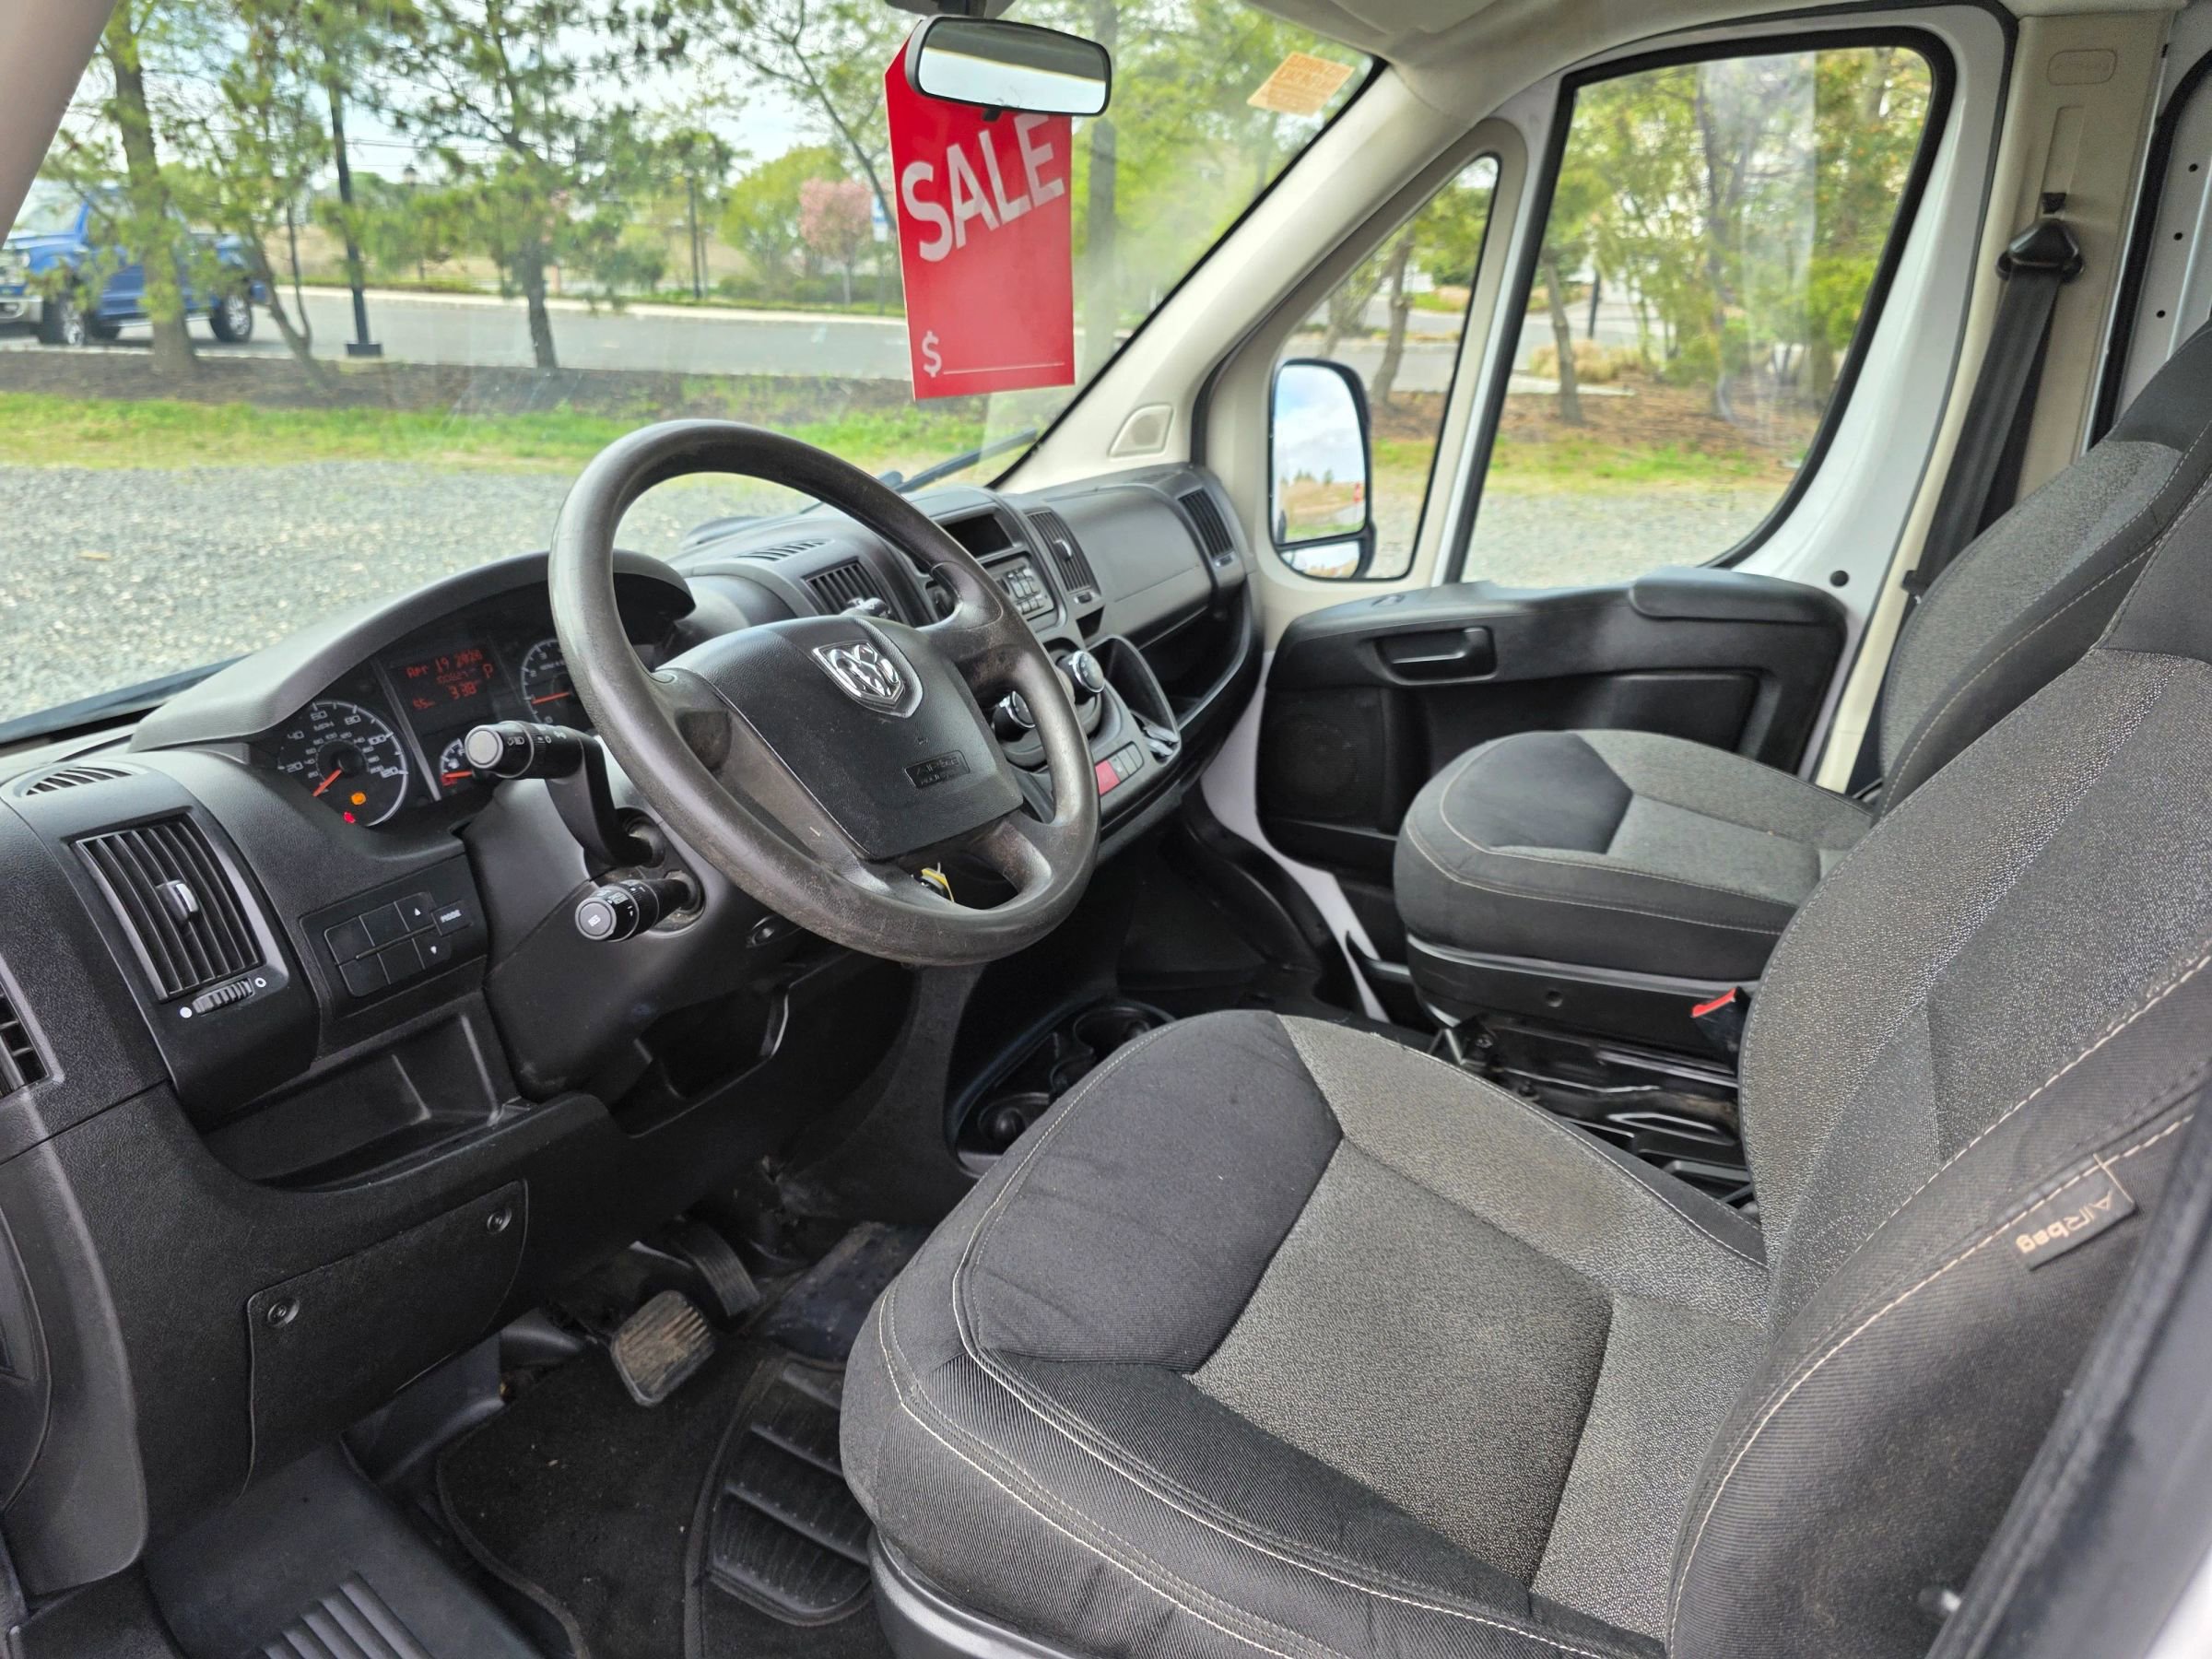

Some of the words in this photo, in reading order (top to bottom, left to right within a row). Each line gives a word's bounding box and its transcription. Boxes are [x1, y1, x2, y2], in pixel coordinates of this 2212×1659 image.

[901, 113, 1065, 262] SALE
[922, 330, 942, 378] $
[344, 714, 361, 725] 80
[286, 761, 304, 773] 20
